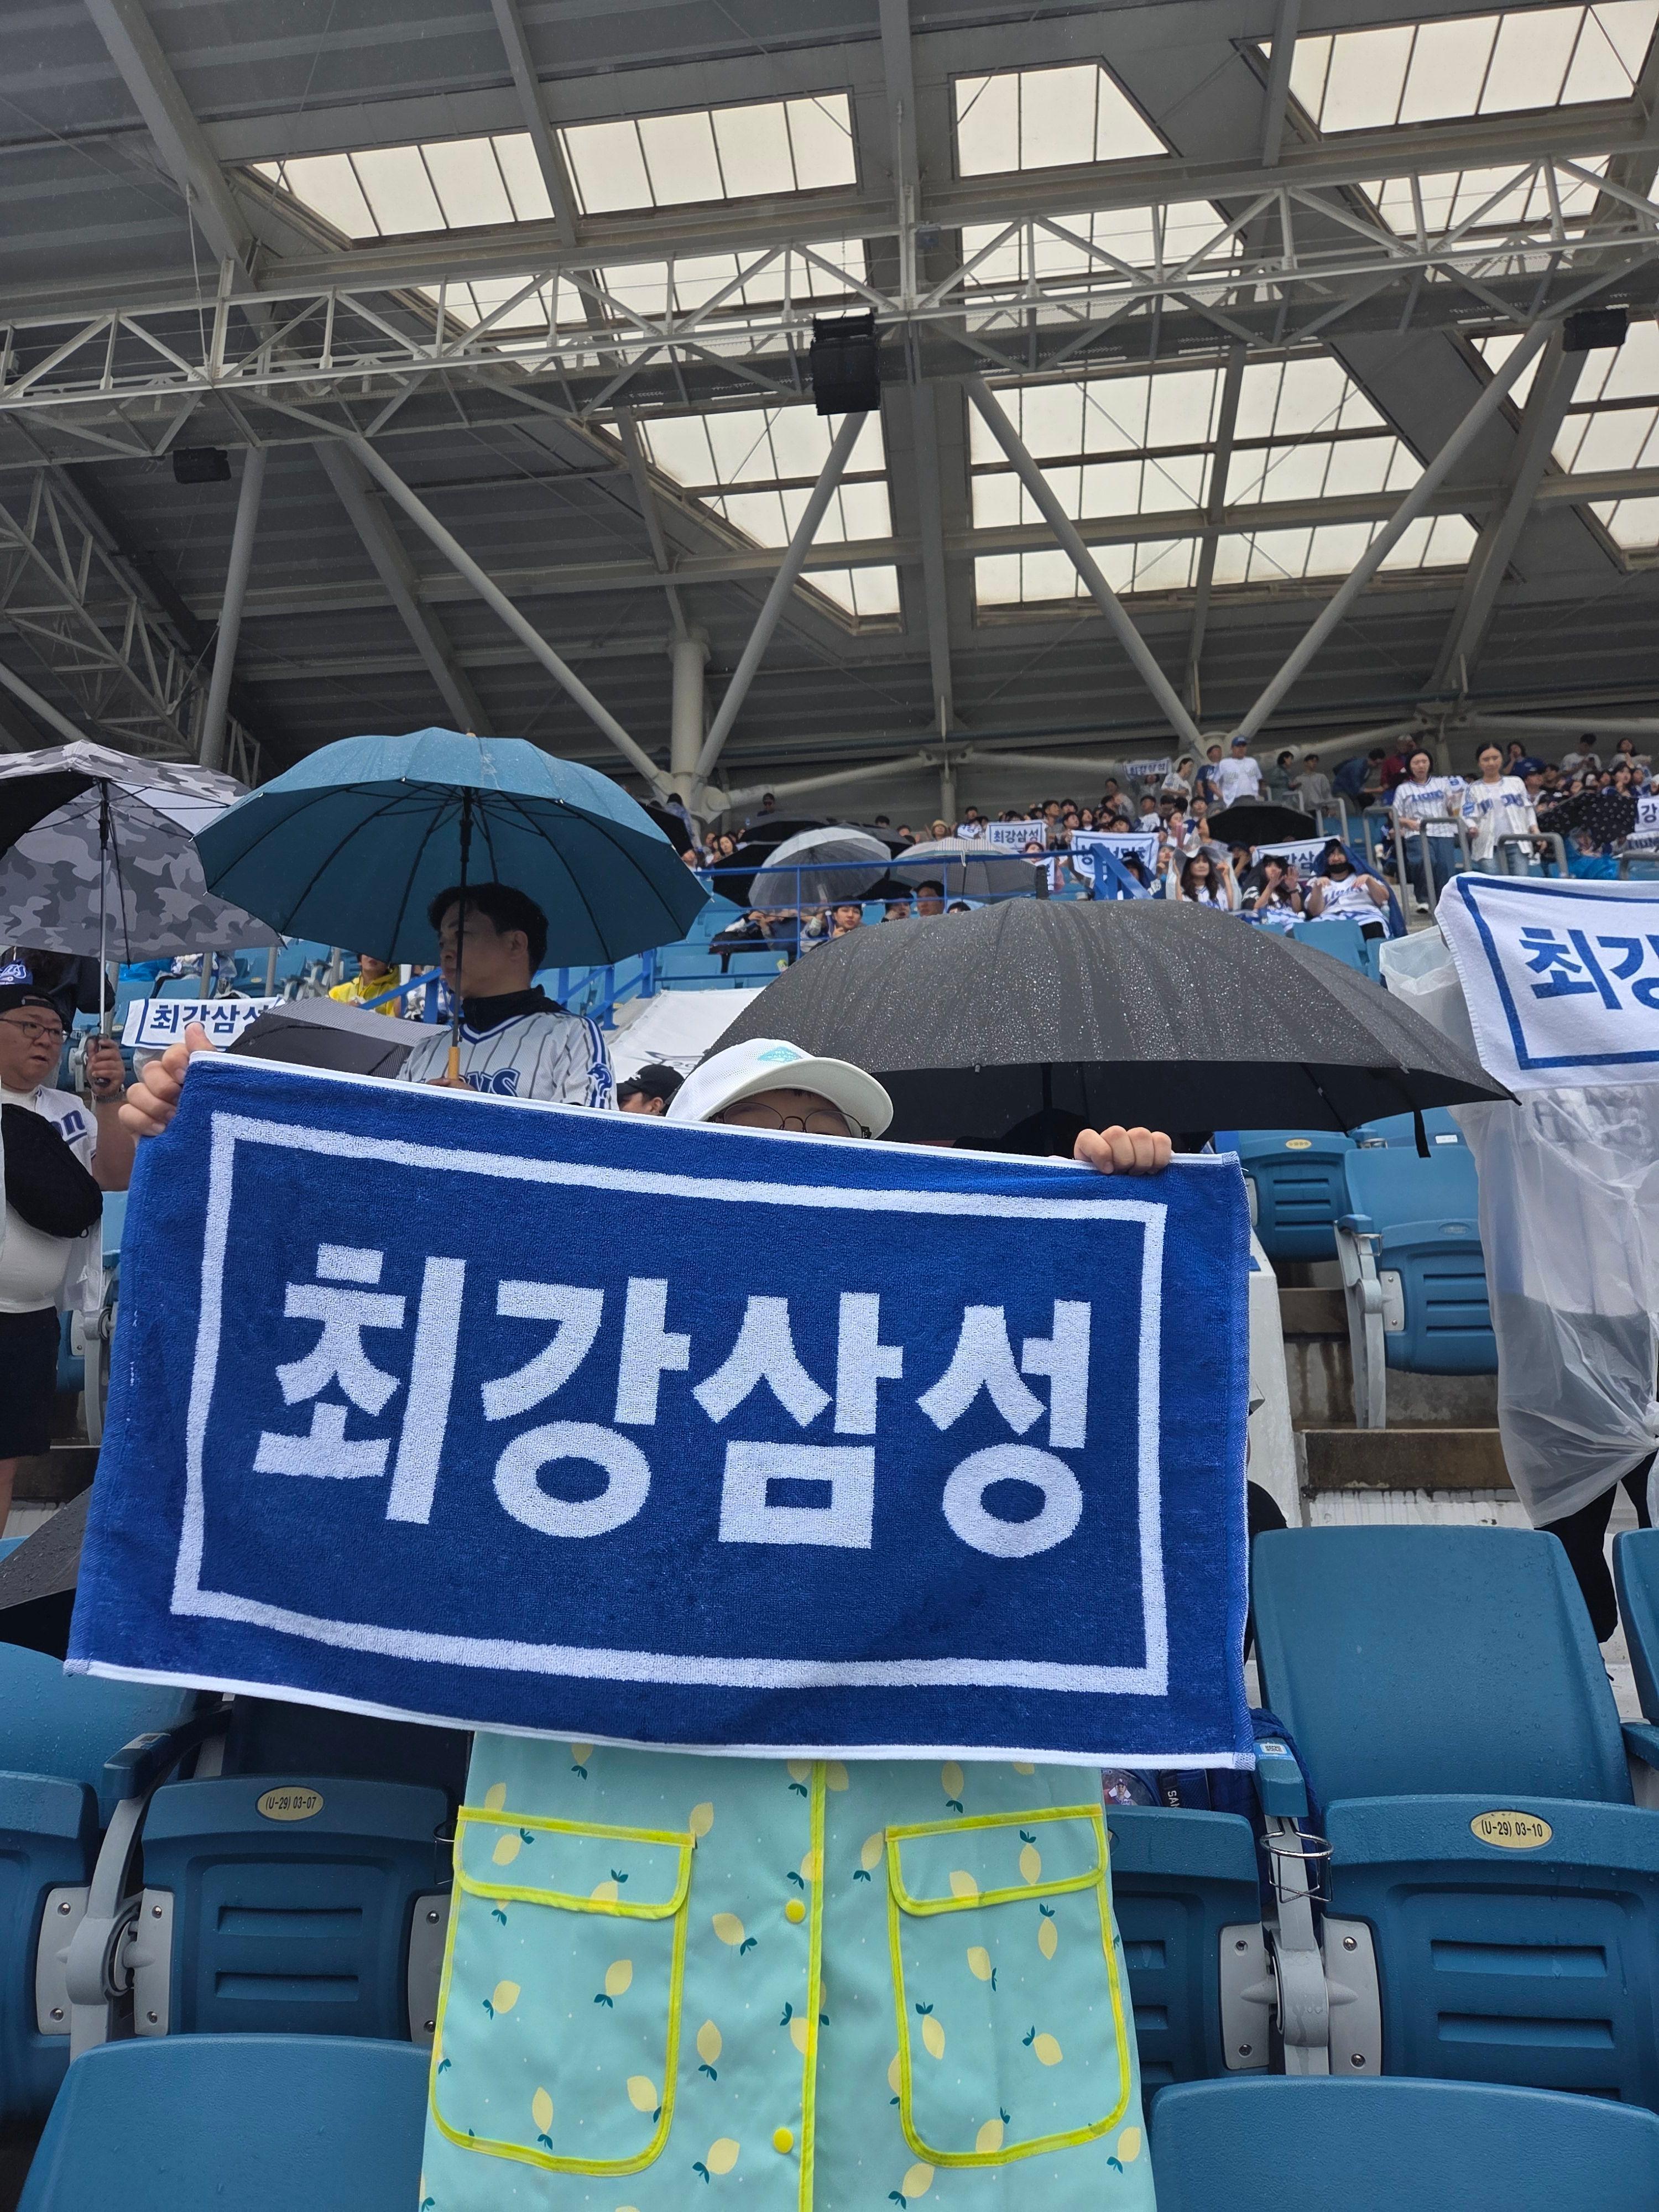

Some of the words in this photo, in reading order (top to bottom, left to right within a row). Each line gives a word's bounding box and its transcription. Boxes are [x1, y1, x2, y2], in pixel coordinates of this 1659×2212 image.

[993, 829, 1039, 844] 최강삼성
[253, 1243, 1092, 1558] 최강삼성
[265, 1796, 291, 1811] (U-29)
[293, 1796, 316, 1809] 03-07
[1481, 1819, 1512, 1837] (U-29)
[1515, 1822, 1543, 1837] 03-10
